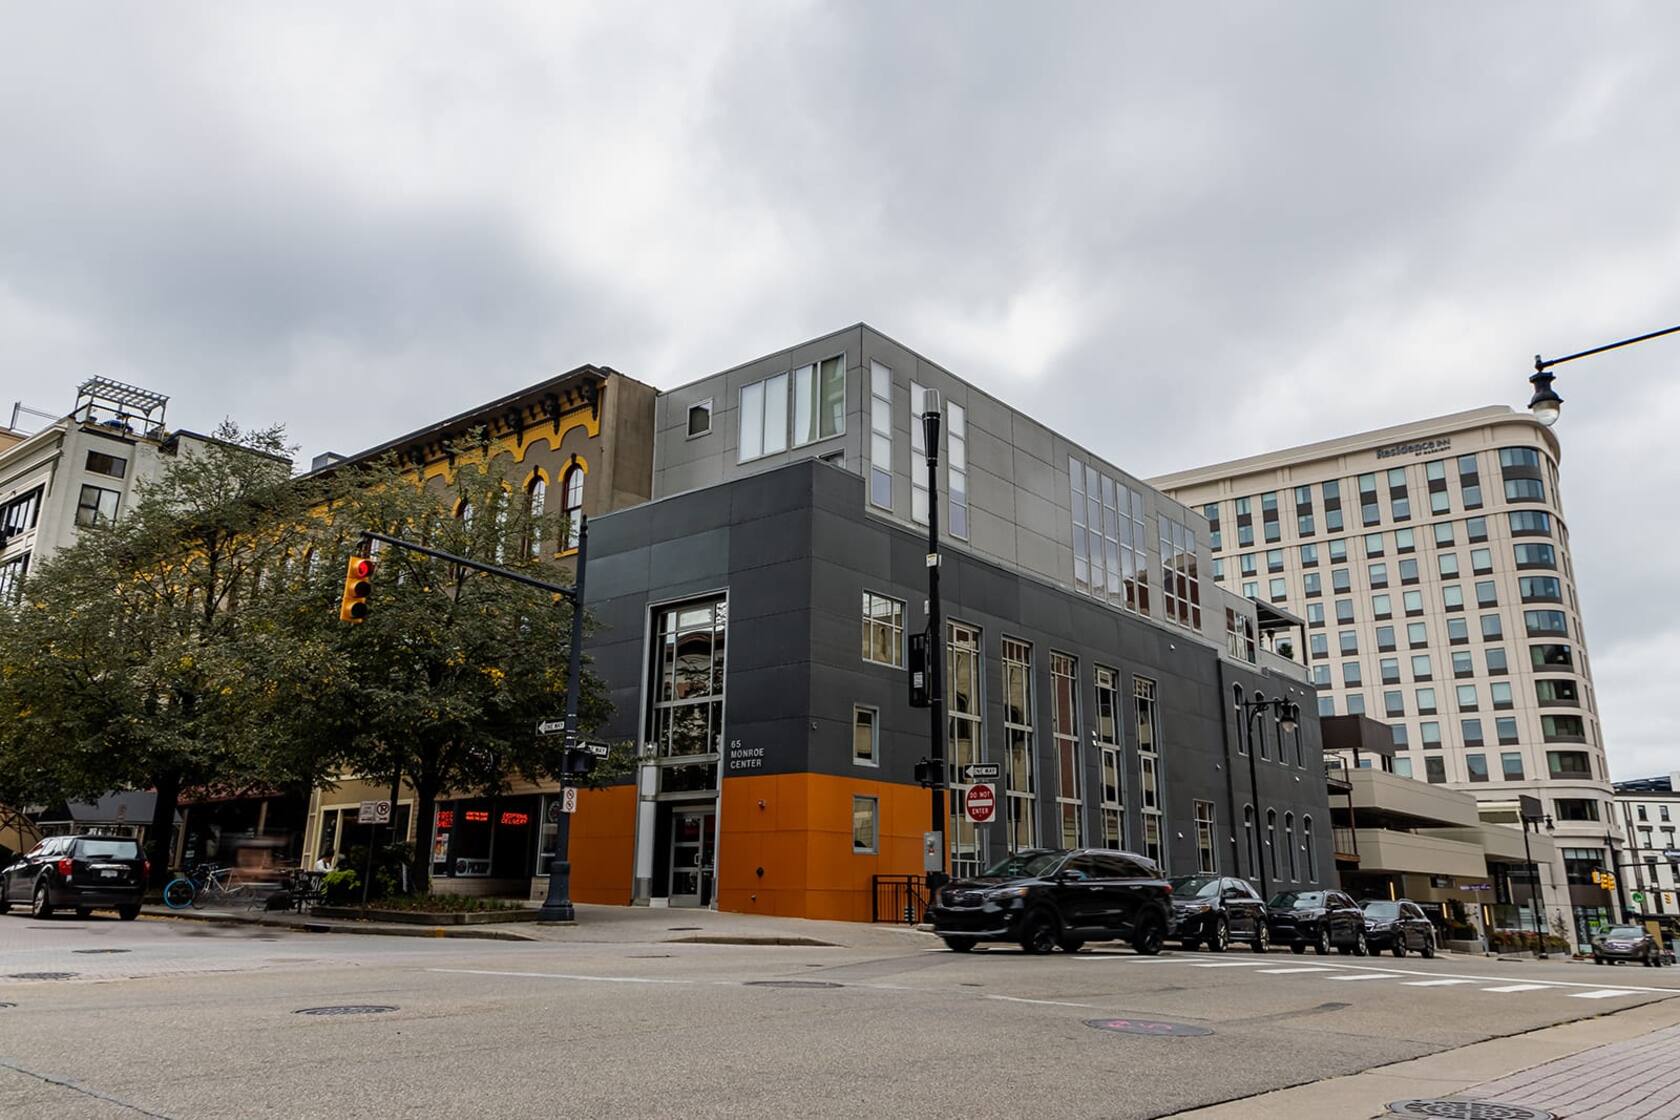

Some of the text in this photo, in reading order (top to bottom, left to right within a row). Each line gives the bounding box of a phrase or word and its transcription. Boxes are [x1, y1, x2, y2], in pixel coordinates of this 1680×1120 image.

[731, 739, 741, 749] 65
[731, 748, 765, 758] MONROE
[730, 759, 762, 769] CENTER
[983, 767, 996, 775] WAY
[970, 791, 990, 799] DO NOT
